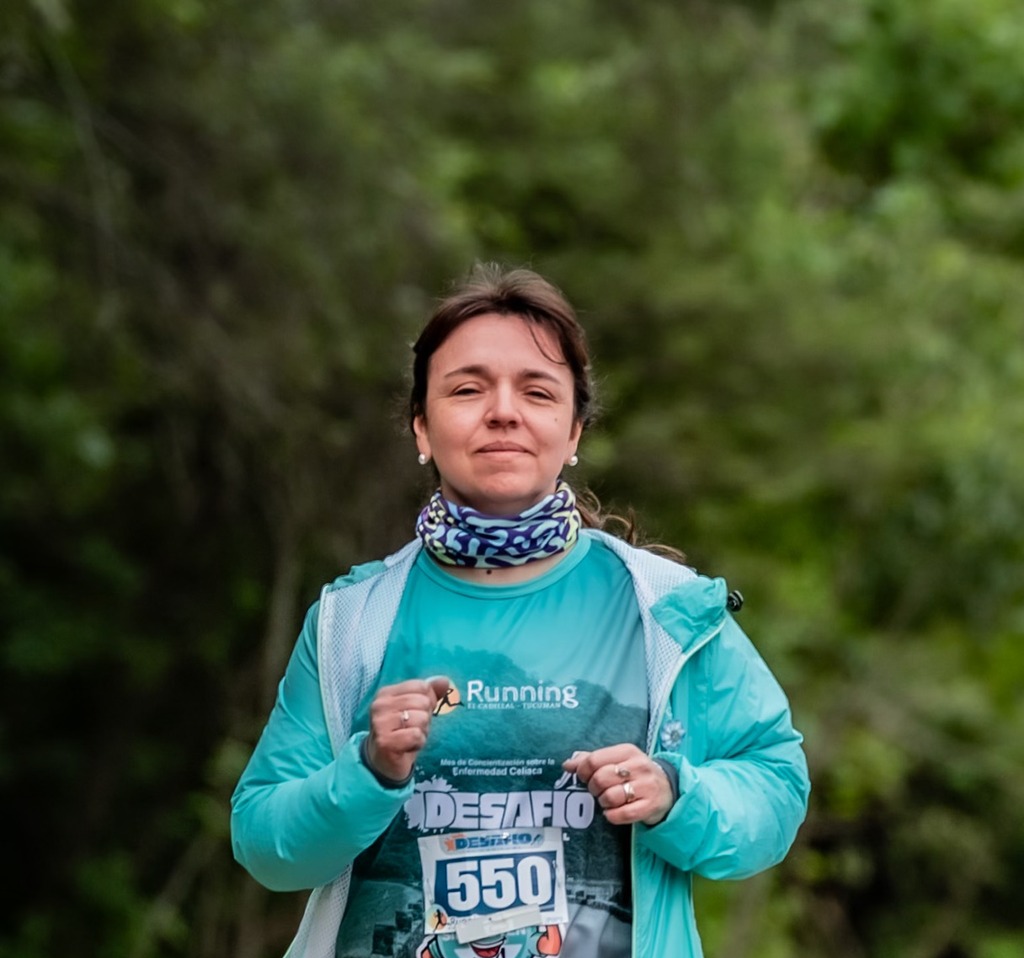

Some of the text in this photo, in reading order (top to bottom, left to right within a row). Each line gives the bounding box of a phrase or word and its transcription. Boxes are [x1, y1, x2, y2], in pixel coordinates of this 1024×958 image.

[467, 680, 579, 709] Running
[440, 759, 456, 767] Mes
[457, 759, 467, 767] de
[526, 758, 547, 767] sobre
[547, 758, 556, 766] la
[452, 767, 508, 777] Enfermedad
[446, 855, 553, 912] 550
